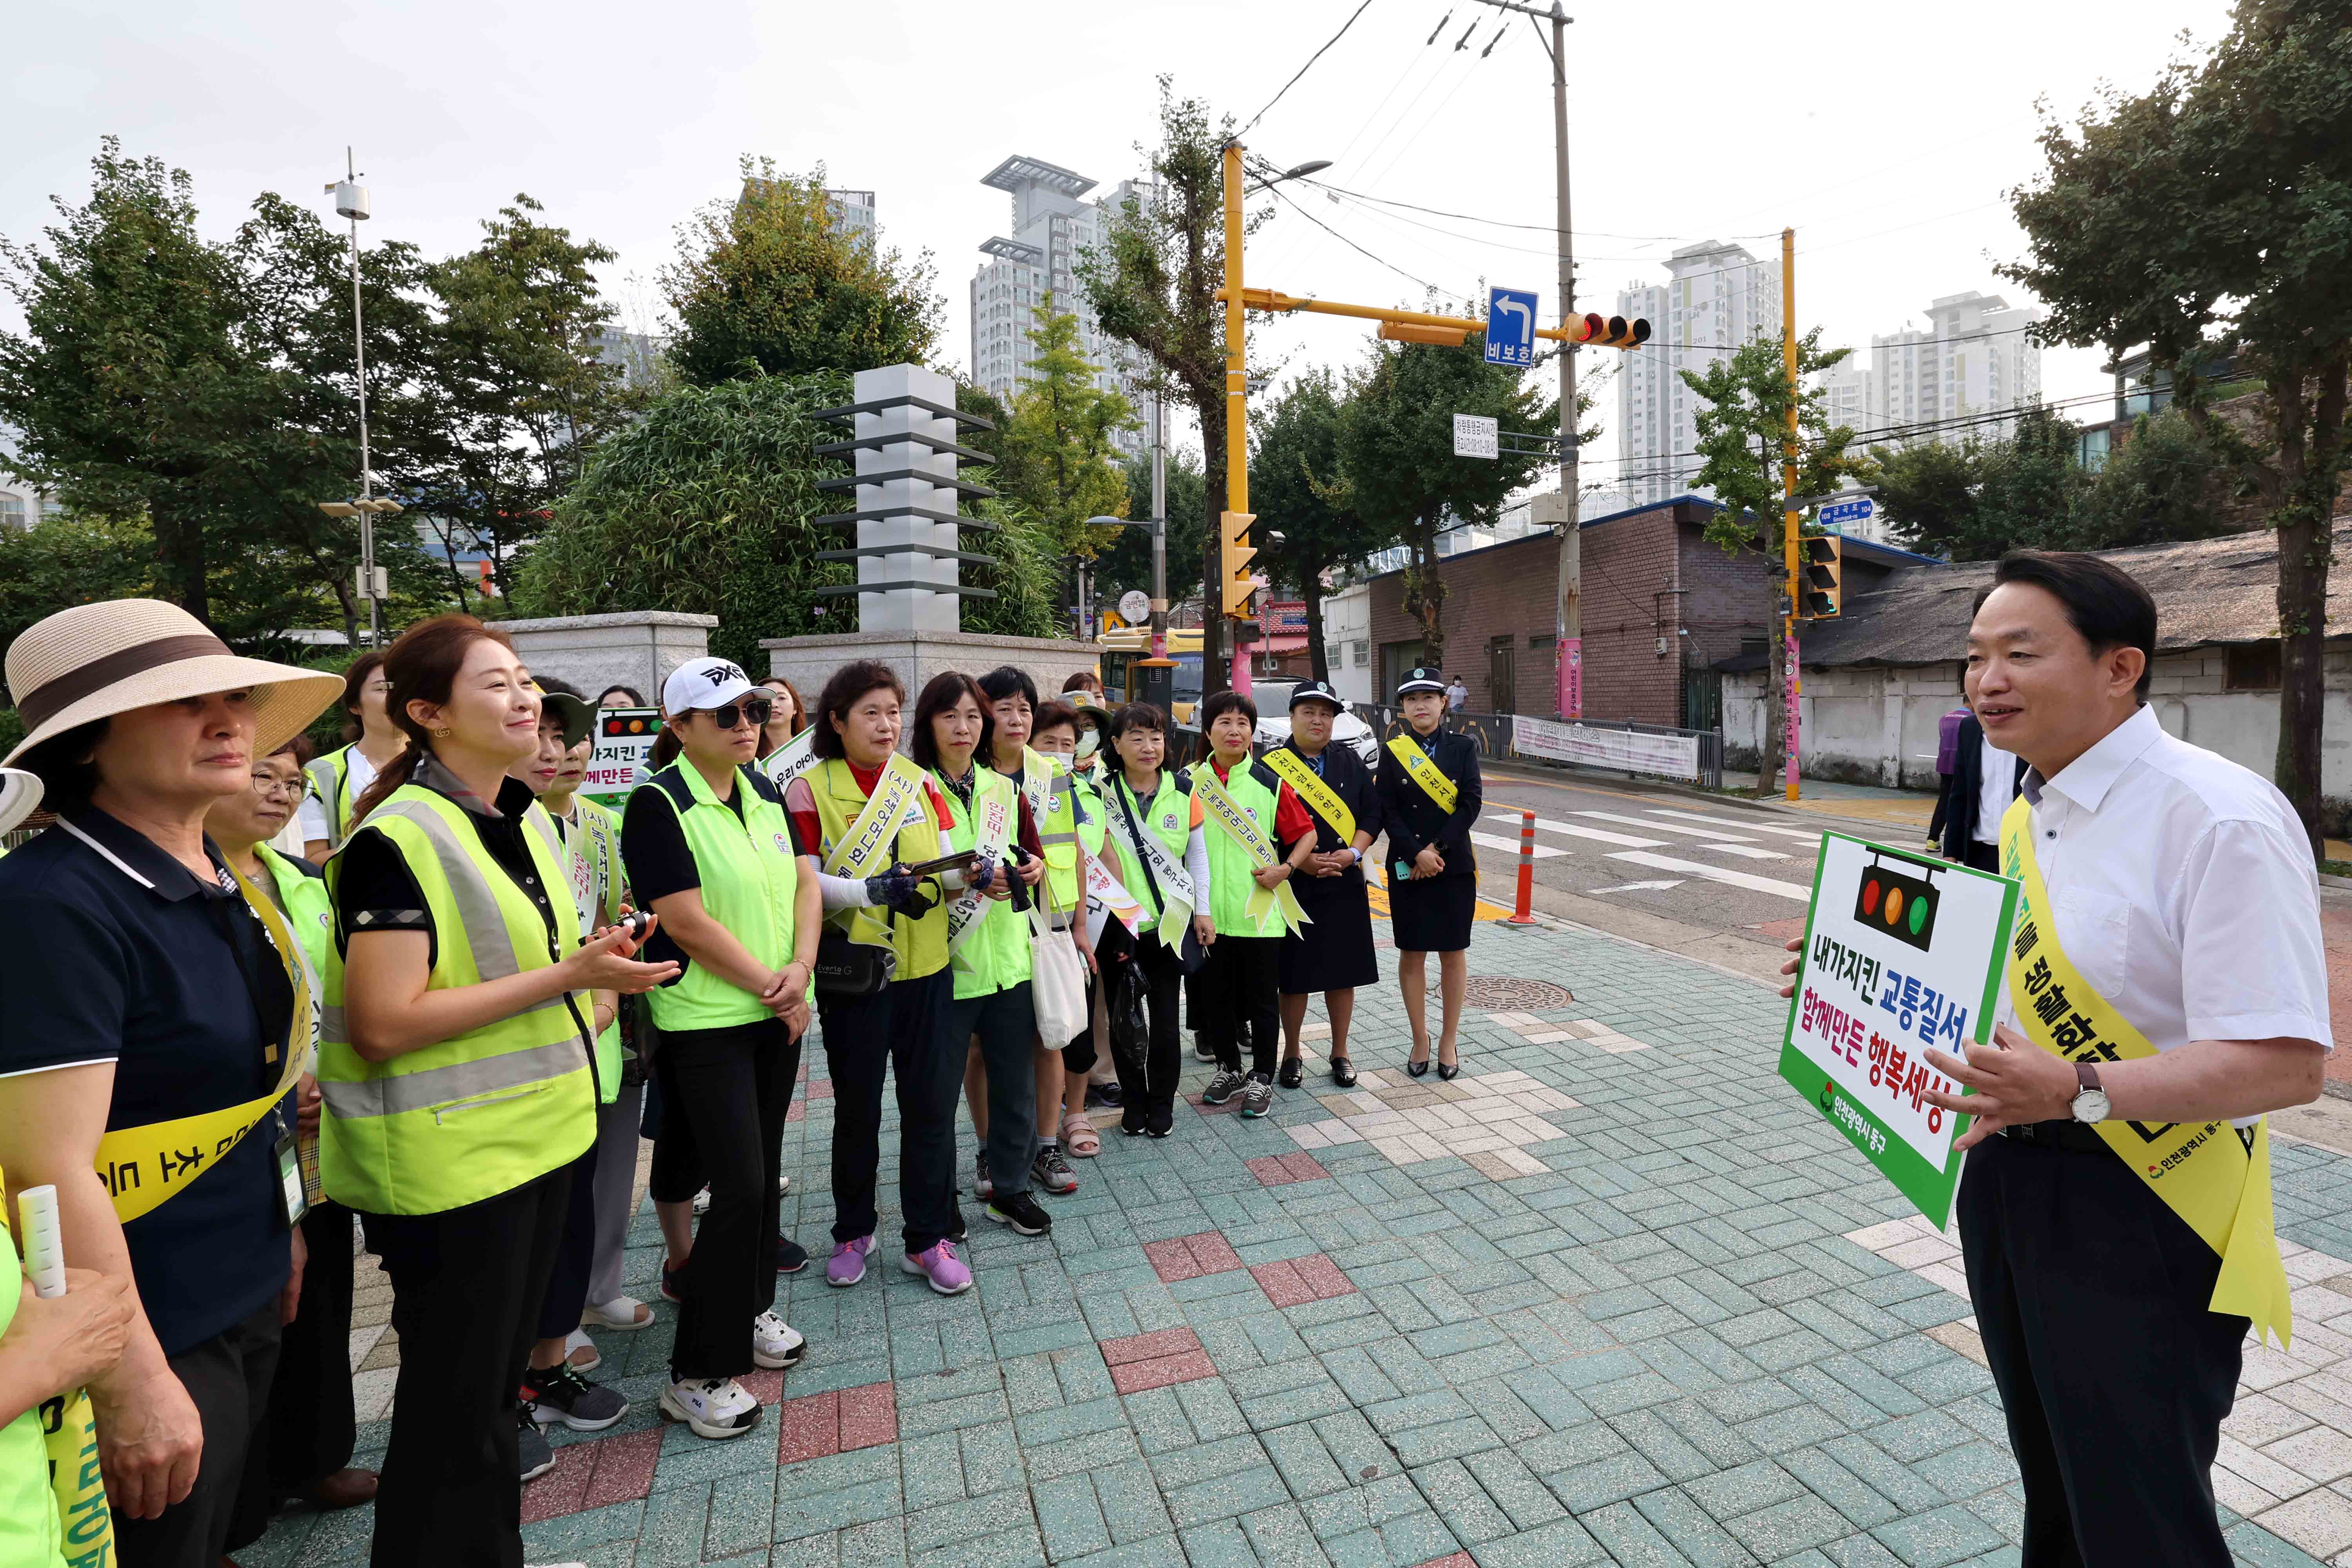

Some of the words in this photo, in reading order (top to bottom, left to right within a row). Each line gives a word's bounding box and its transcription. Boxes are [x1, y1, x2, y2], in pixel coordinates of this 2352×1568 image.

[1488, 342, 1530, 363] 비보호
[1457, 419, 1495, 436] 차량통행금지시간
[1833, 504, 1858, 515] 금곡로
[1862, 505, 1871, 514] 104
[1833, 514, 1858, 522] Geumgok-ro
[699, 665, 746, 687] PXG
[777, 766, 794, 786] 우리
[848, 787, 901, 866] 녹색어머니회
[1207, 793, 1258, 845] 녹색어머니회
[1813, 933, 1881, 1006] 내가지킨
[1880, 968, 1967, 1054] 교통질서
[1801, 985, 1866, 1069] 함께만든
[1868, 1031, 1951, 1134] 행복세상
[1834, 1095, 1870, 1142] 인천광역시
[1870, 1123, 1887, 1155] 동구
[2160, 1132, 2208, 1171] 인천광역시
[691, 1398, 702, 1408] FILA
